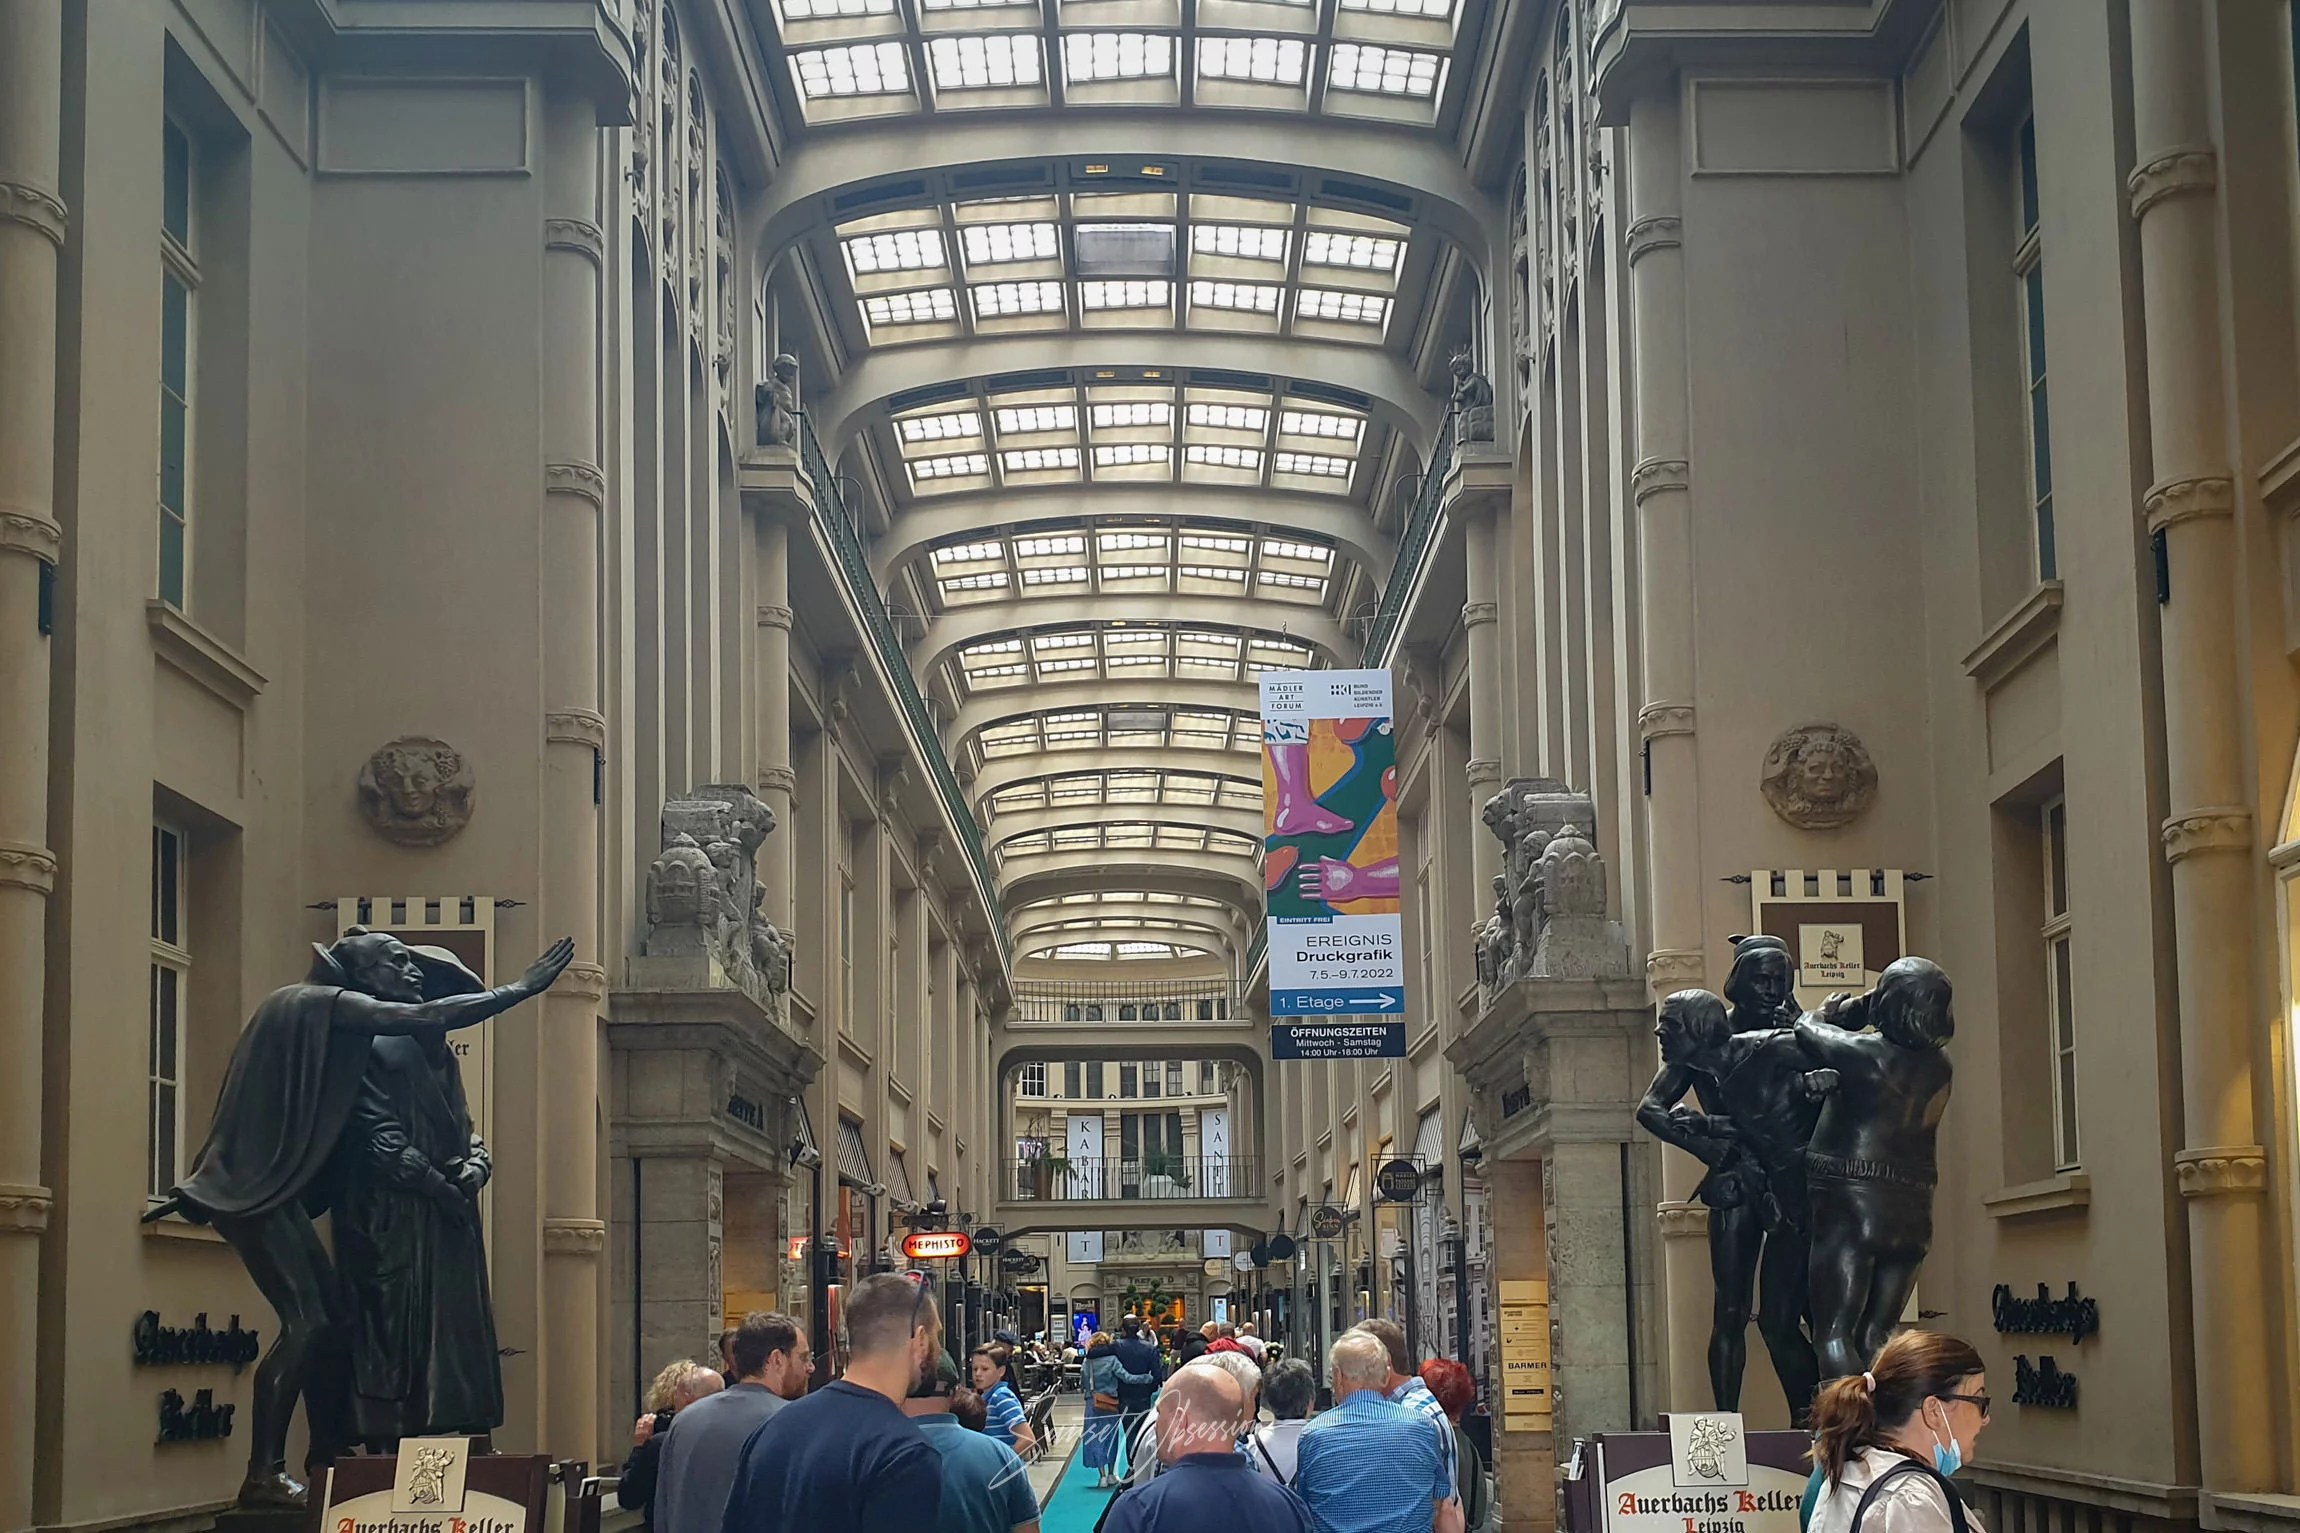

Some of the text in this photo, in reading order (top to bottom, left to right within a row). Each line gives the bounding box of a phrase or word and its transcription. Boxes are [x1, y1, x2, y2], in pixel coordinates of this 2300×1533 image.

[1269, 683, 1303, 692] MÄDLER
[1306, 934, 1392, 947] EREIGNIS
[1296, 949, 1393, 963] Druckgrafik
[1280, 996, 1344, 1010] 1. Etage
[1290, 1027, 1387, 1037] ÖFFNUNGSZEITEN
[1296, 1039, 1334, 1047] Mittwoch
[1343, 1038, 1381, 1047] Samstag
[908, 1239, 963, 1249] MEPHISTO
[1508, 1362, 1547, 1370] BARMER
[1618, 1490, 1803, 1515] Auerbachs Keller
